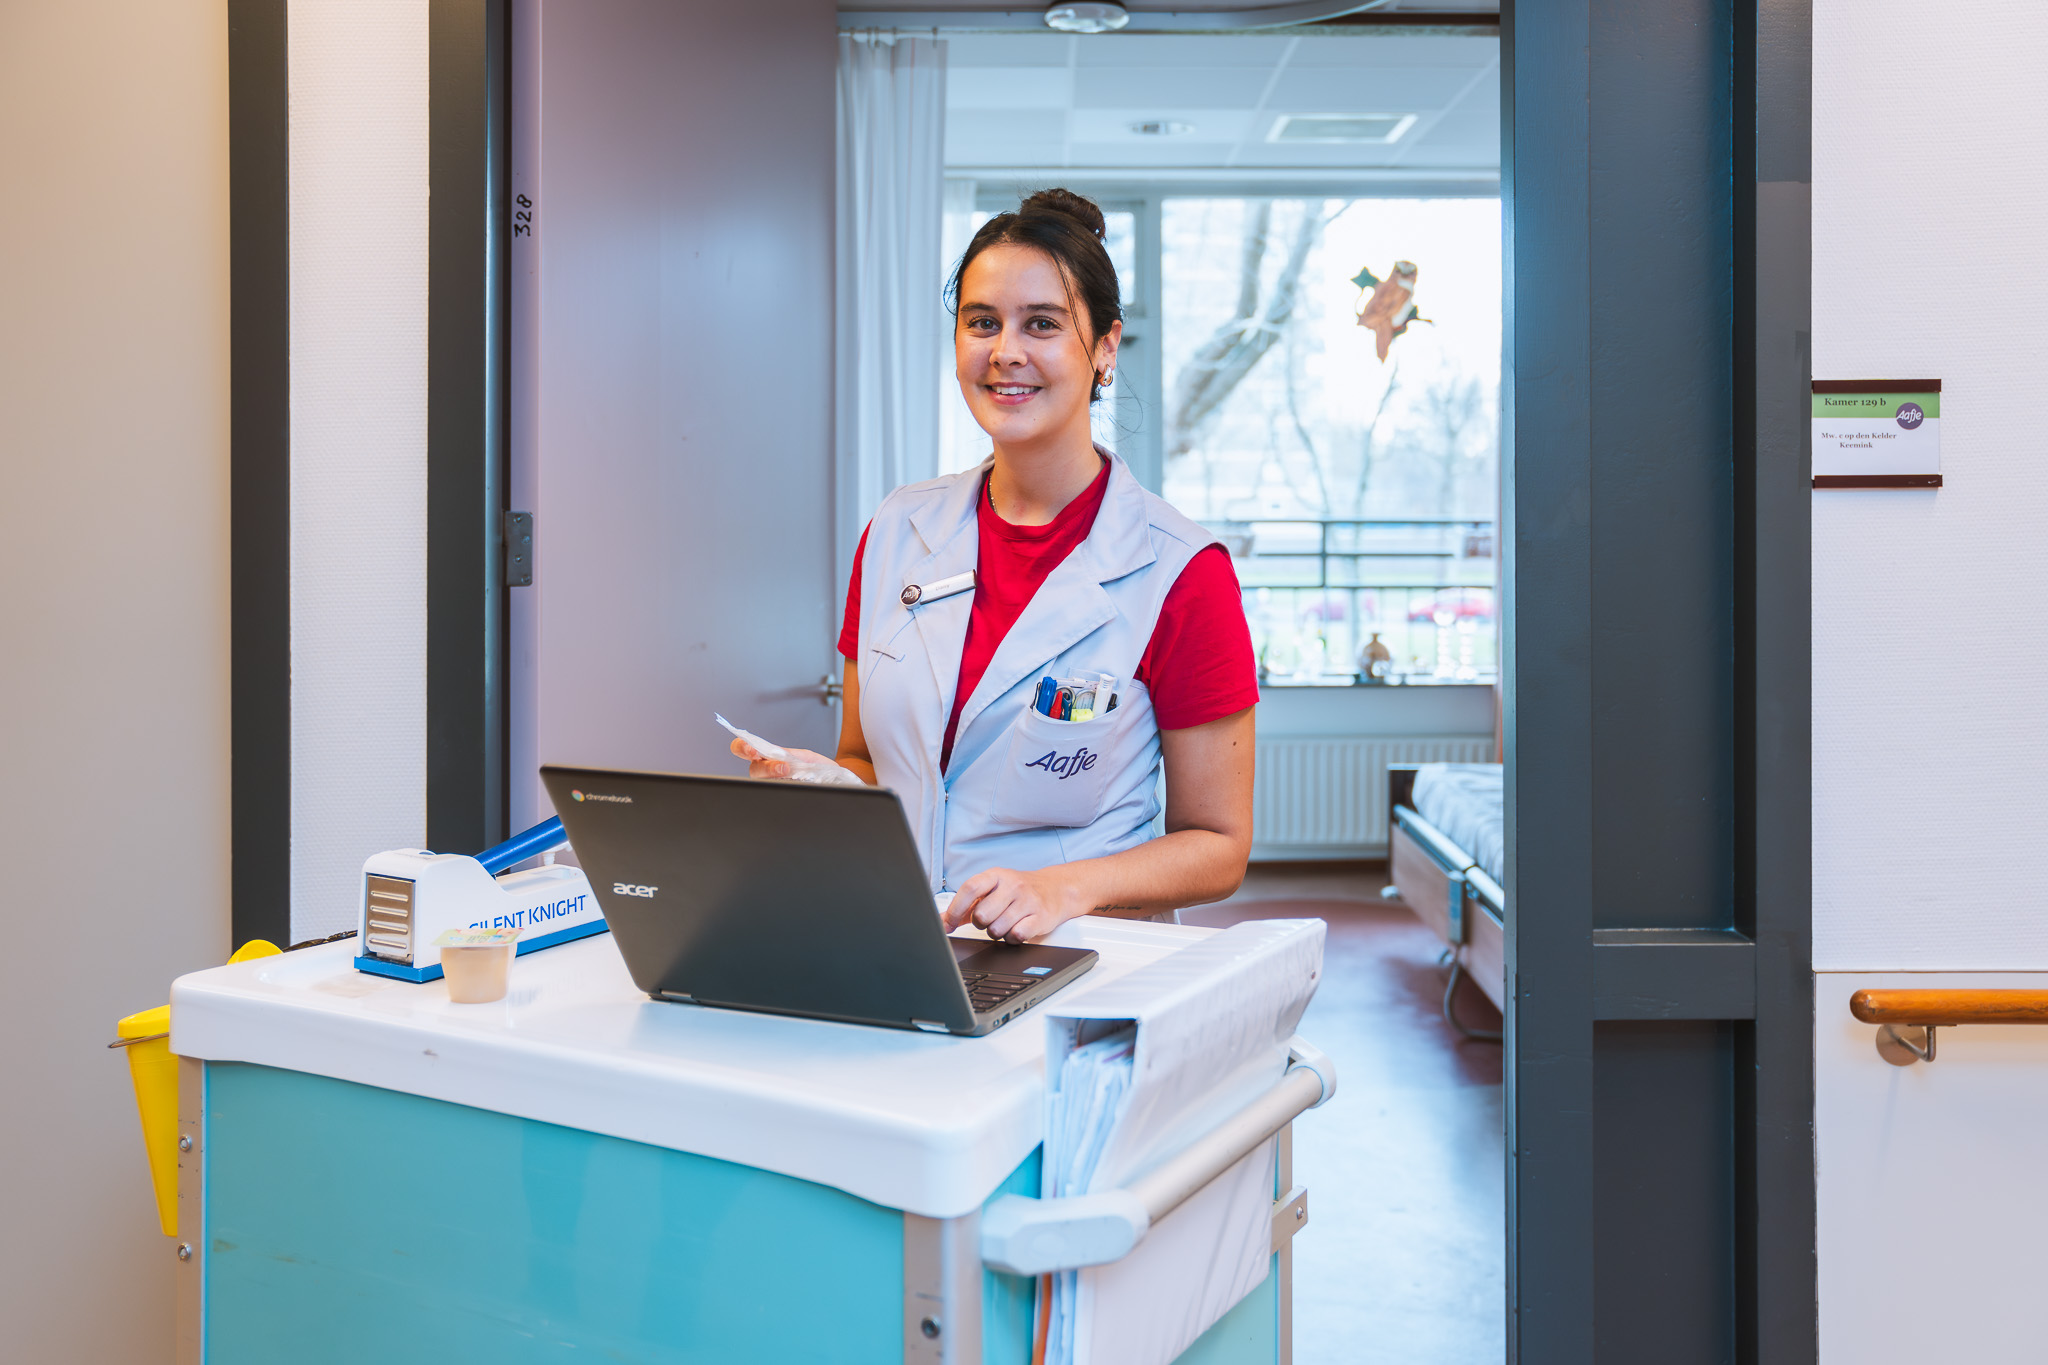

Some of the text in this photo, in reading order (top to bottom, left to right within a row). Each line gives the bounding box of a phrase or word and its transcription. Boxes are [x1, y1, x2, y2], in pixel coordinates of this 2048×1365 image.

[513, 193, 533, 238] 328
[1824, 397, 1887, 408] Kamer 129 b
[1896, 408, 1922, 424] Aafje
[1025, 747, 1098, 780] Aafje
[585, 792, 634, 803] chromebook
[613, 882, 659, 898] acer
[528, 894, 587, 925] KNIGHT
